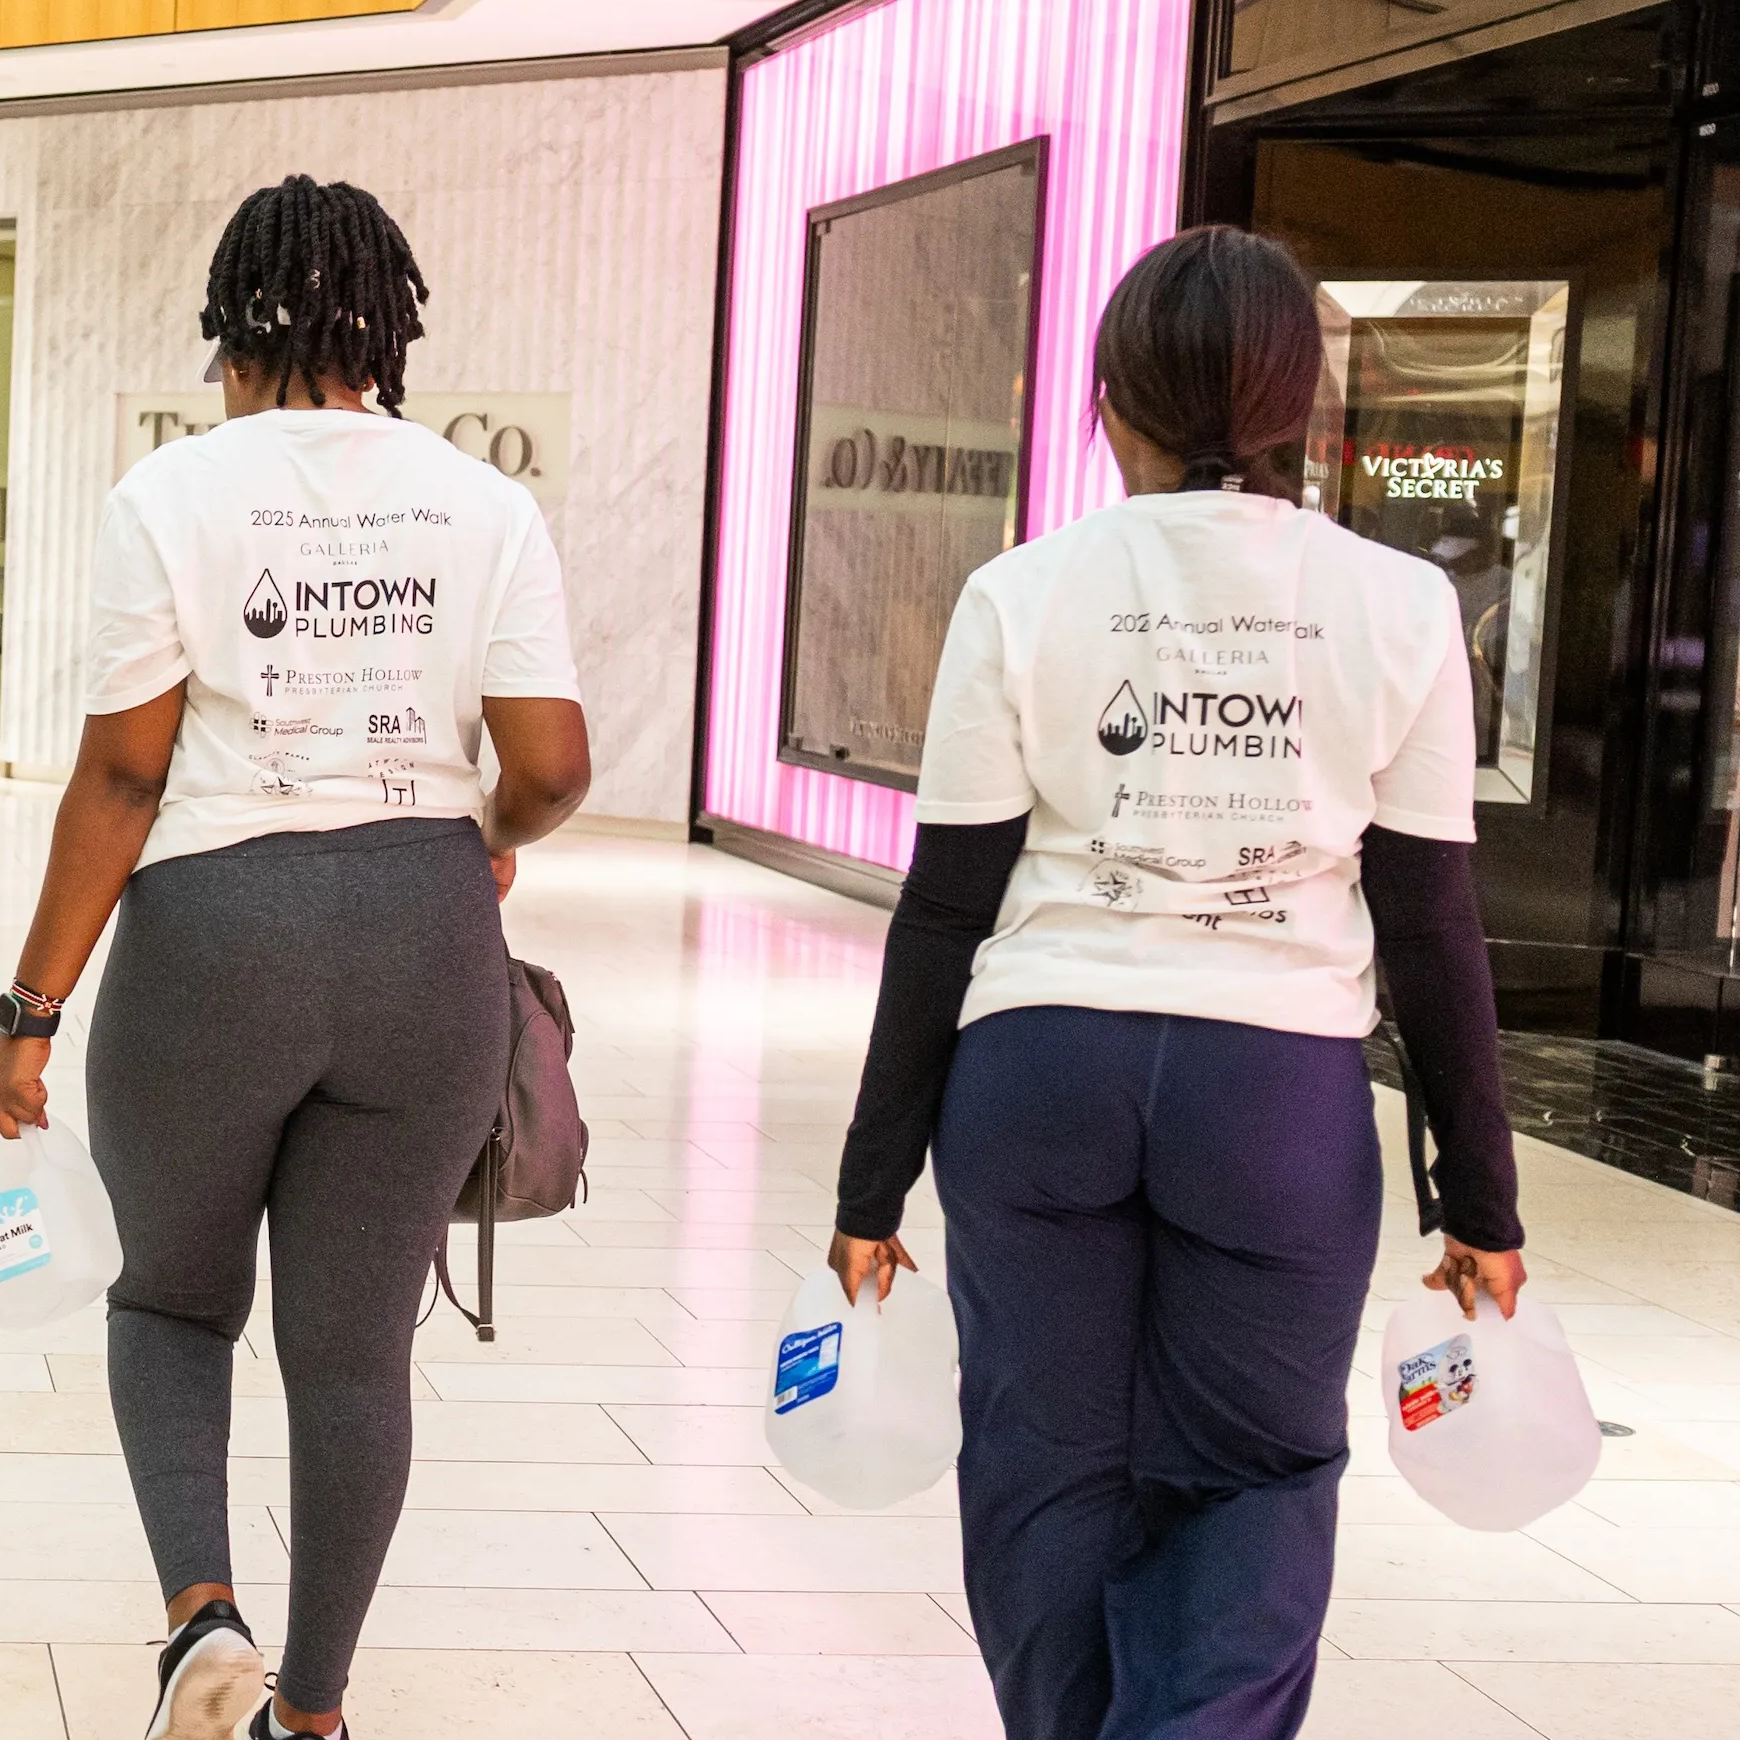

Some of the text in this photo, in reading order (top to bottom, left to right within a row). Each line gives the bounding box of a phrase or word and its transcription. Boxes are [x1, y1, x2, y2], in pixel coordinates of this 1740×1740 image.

[1362, 452, 1504, 479] VICTORIA'S
[1386, 476, 1480, 499] SECRET
[250, 507, 452, 529] 2025 Annual Water Walk
[300, 539, 390, 558] GALLERIA
[295, 576, 436, 612] INTOWN
[295, 613, 434, 639] PLUMBING
[1156, 614, 1223, 634] Annual
[1231, 615, 1291, 633] Water
[1293, 622, 1325, 640] alk
[1156, 646, 1270, 666] GALLERIA
[286, 667, 423, 685] PRESTON HOLLOW
[284, 684, 404, 695] PRESBYTERIAN CHURCH
[1153, 691, 1303, 728] INTOW
[273, 724, 344, 738] Medical Group
[368, 714, 401, 735] SRA
[1151, 732, 1302, 759] PLUMBIN
[1136, 791, 1313, 811] PRESTON HOLLOW
[1231, 812, 1285, 823] CHURCH
[1166, 856, 1207, 869] Group
[1238, 845, 1276, 866] SRA
[10, 1223, 34, 1239] Milk
